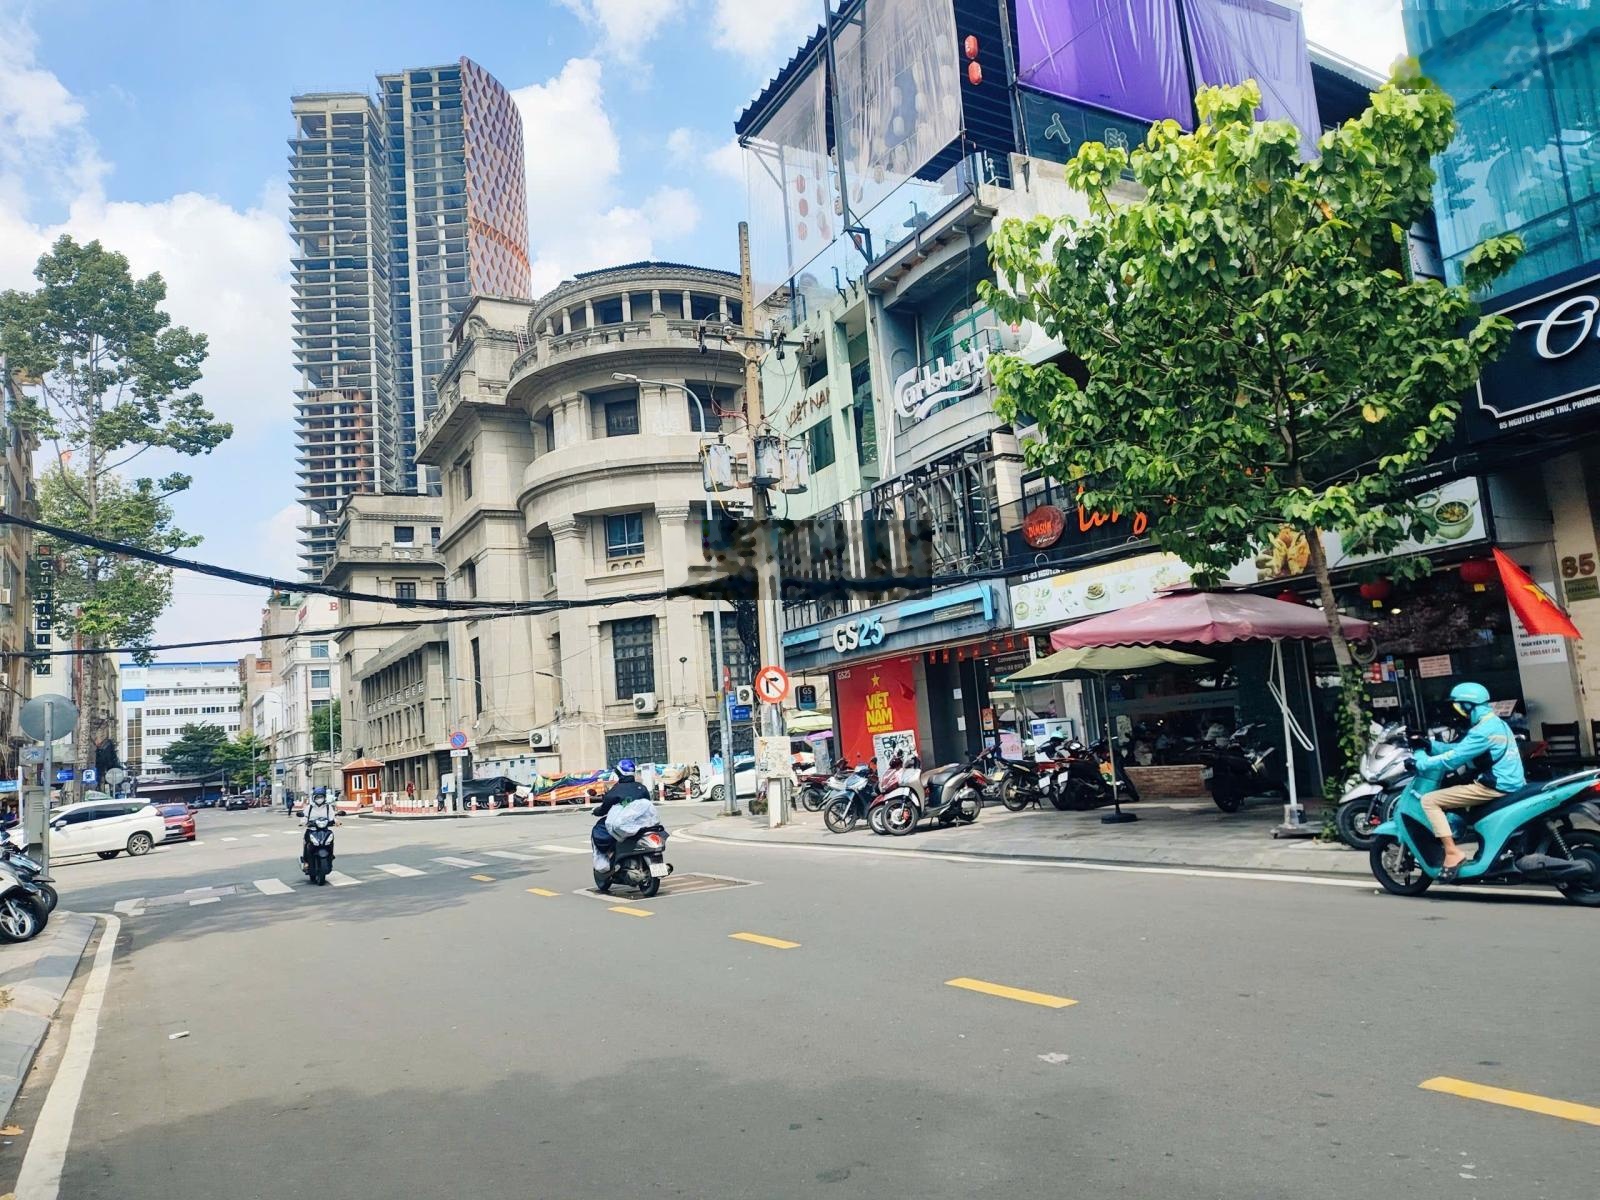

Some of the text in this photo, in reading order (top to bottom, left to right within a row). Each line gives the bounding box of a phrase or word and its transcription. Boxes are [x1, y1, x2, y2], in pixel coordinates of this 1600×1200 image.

[894, 344, 990, 419] Carlsberg
[1561, 552, 1596, 579] 85
[832, 614, 885, 653] GS25
[838, 670, 851, 680] GS25
[802, 687, 812, 695] GS
[865, 690, 890, 711] VIỆT
[865, 707, 893, 727] NAM
